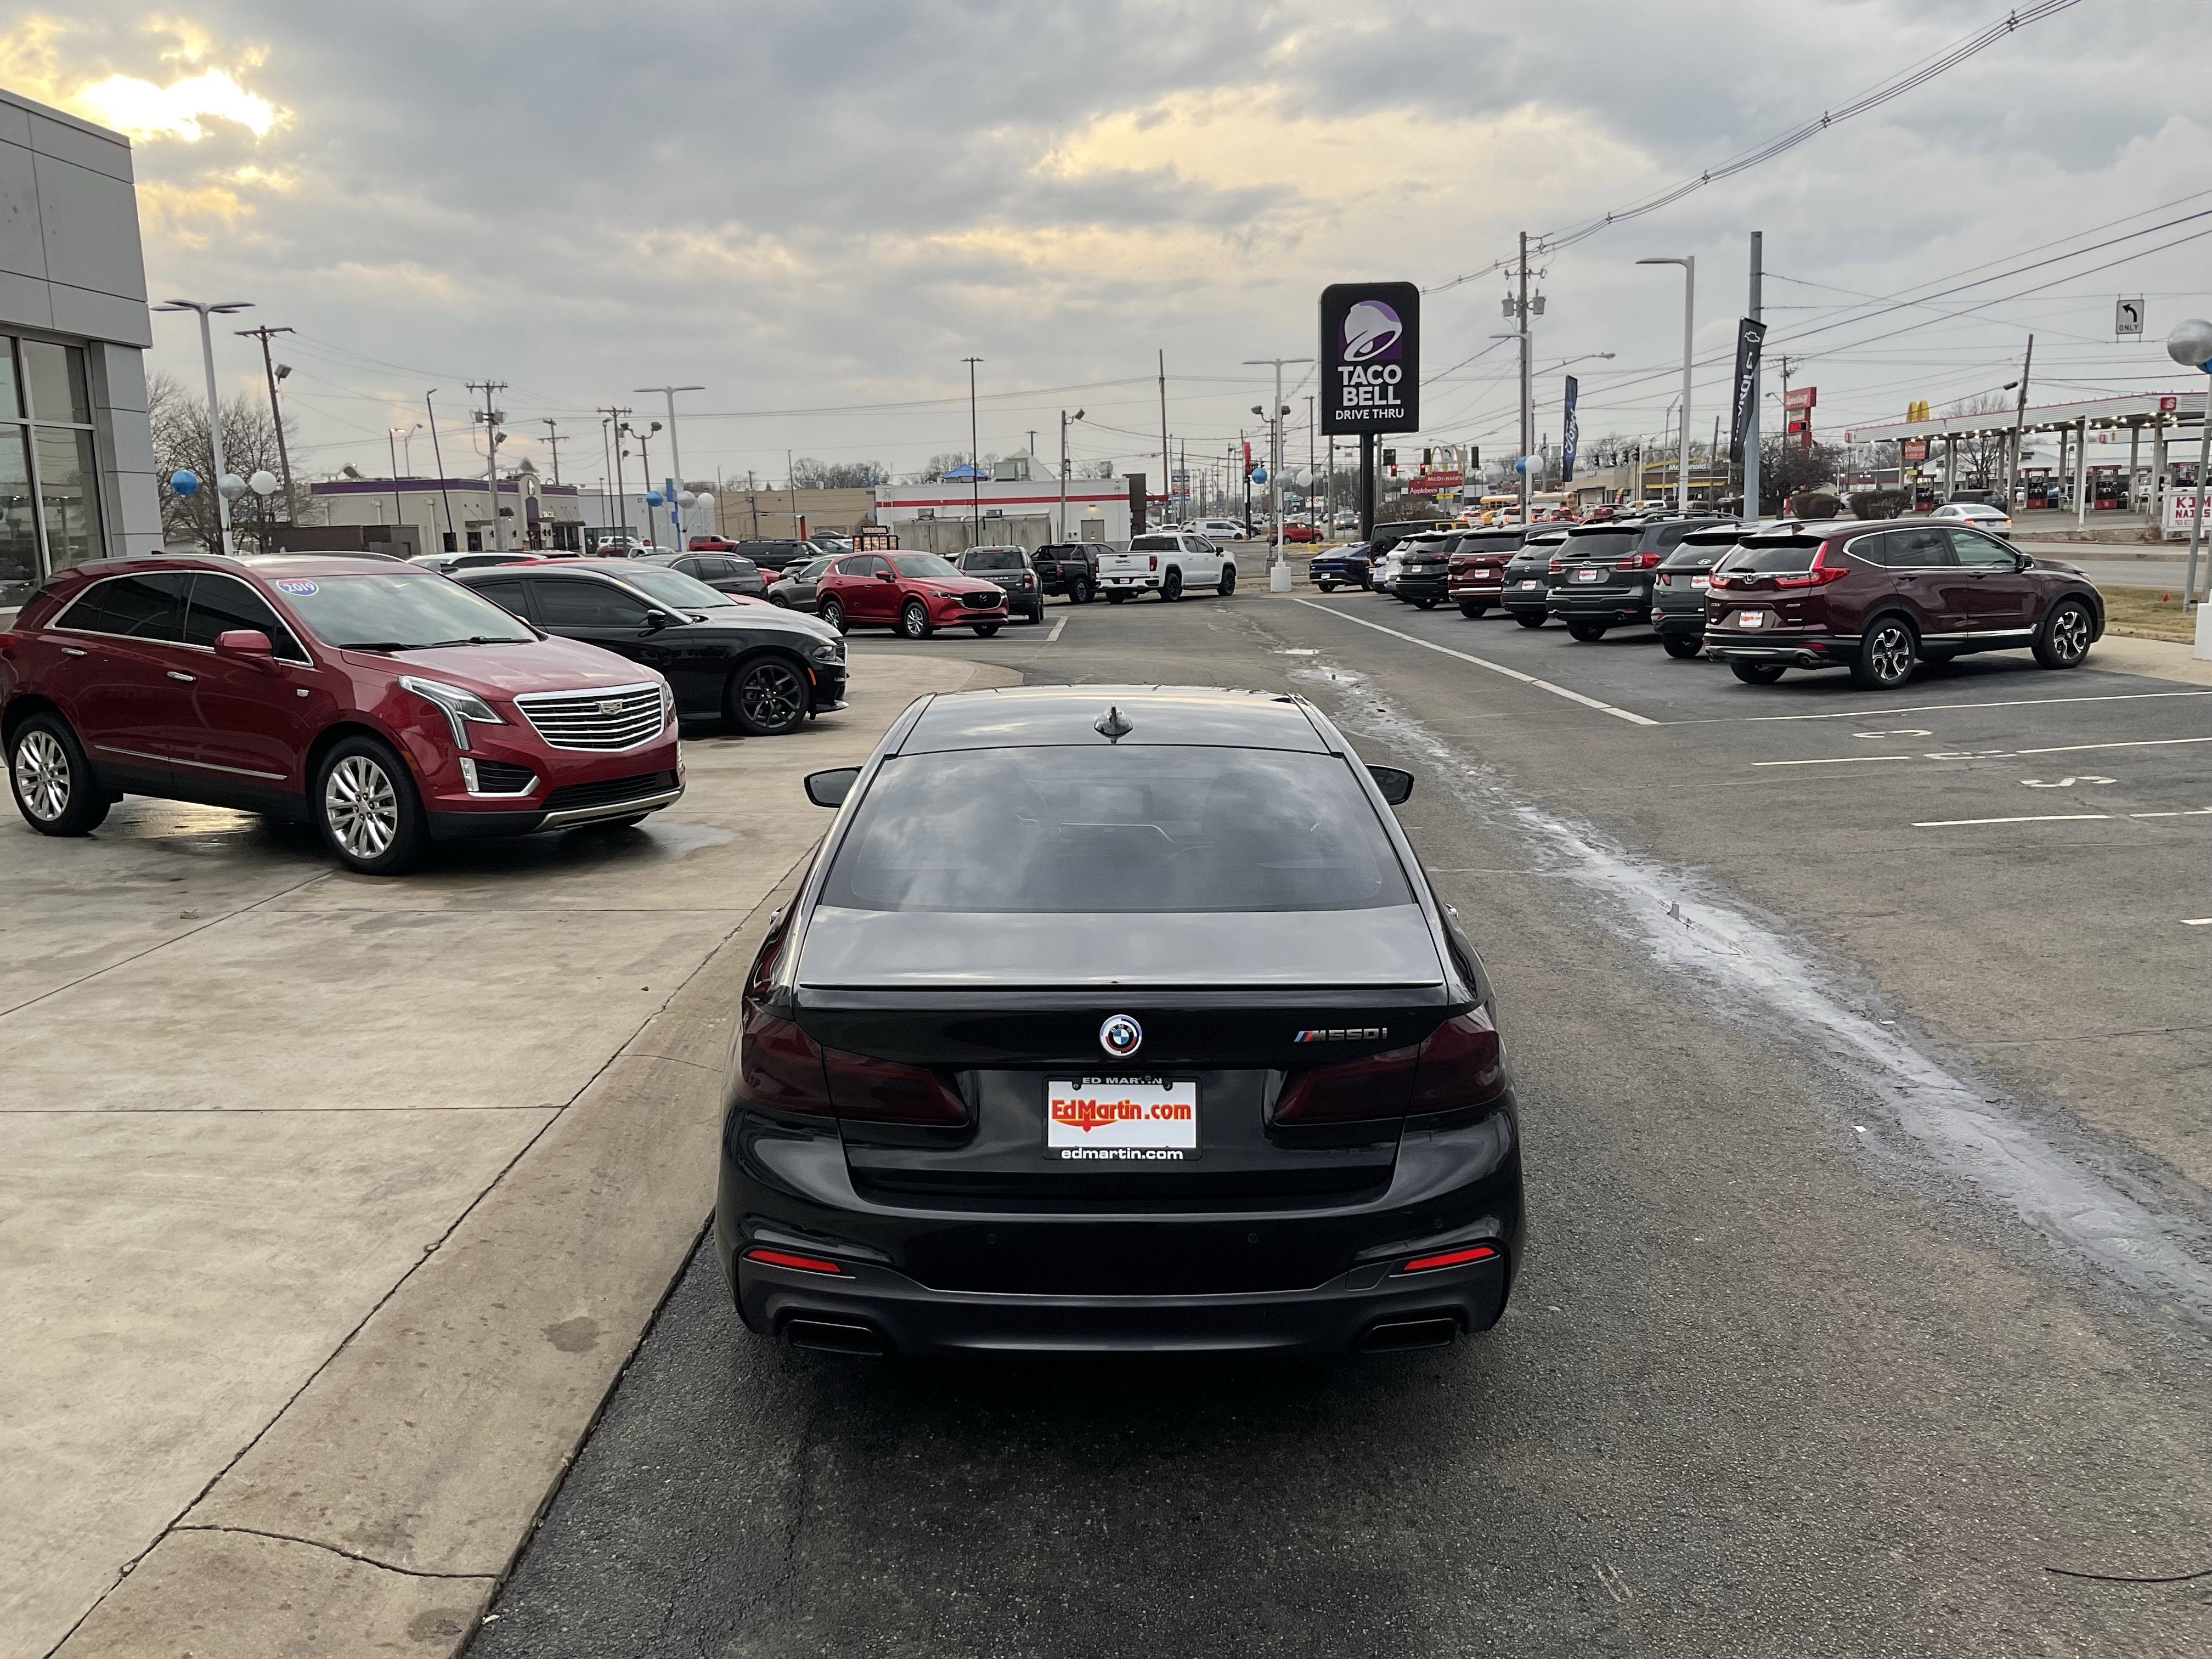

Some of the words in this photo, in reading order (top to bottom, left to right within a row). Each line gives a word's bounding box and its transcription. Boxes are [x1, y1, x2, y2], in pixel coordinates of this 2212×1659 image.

[1338, 364, 1402, 385] TACO
[1343, 386, 1401, 406] BELL
[1335, 409, 1370, 420] DRIVE
[1372, 408, 1404, 419] THRU
[1565, 408, 1576, 454] Ford
[2175, 509, 2210, 518] NAIS
[283, 583, 315, 592] 2019
[1110, 1023, 1132, 1033] BMW
[1306, 1028, 1387, 1042] M550i
[1052, 1099, 1192, 1127] EdMartin.com
[1061, 1147, 1183, 1160] edmartin.com
